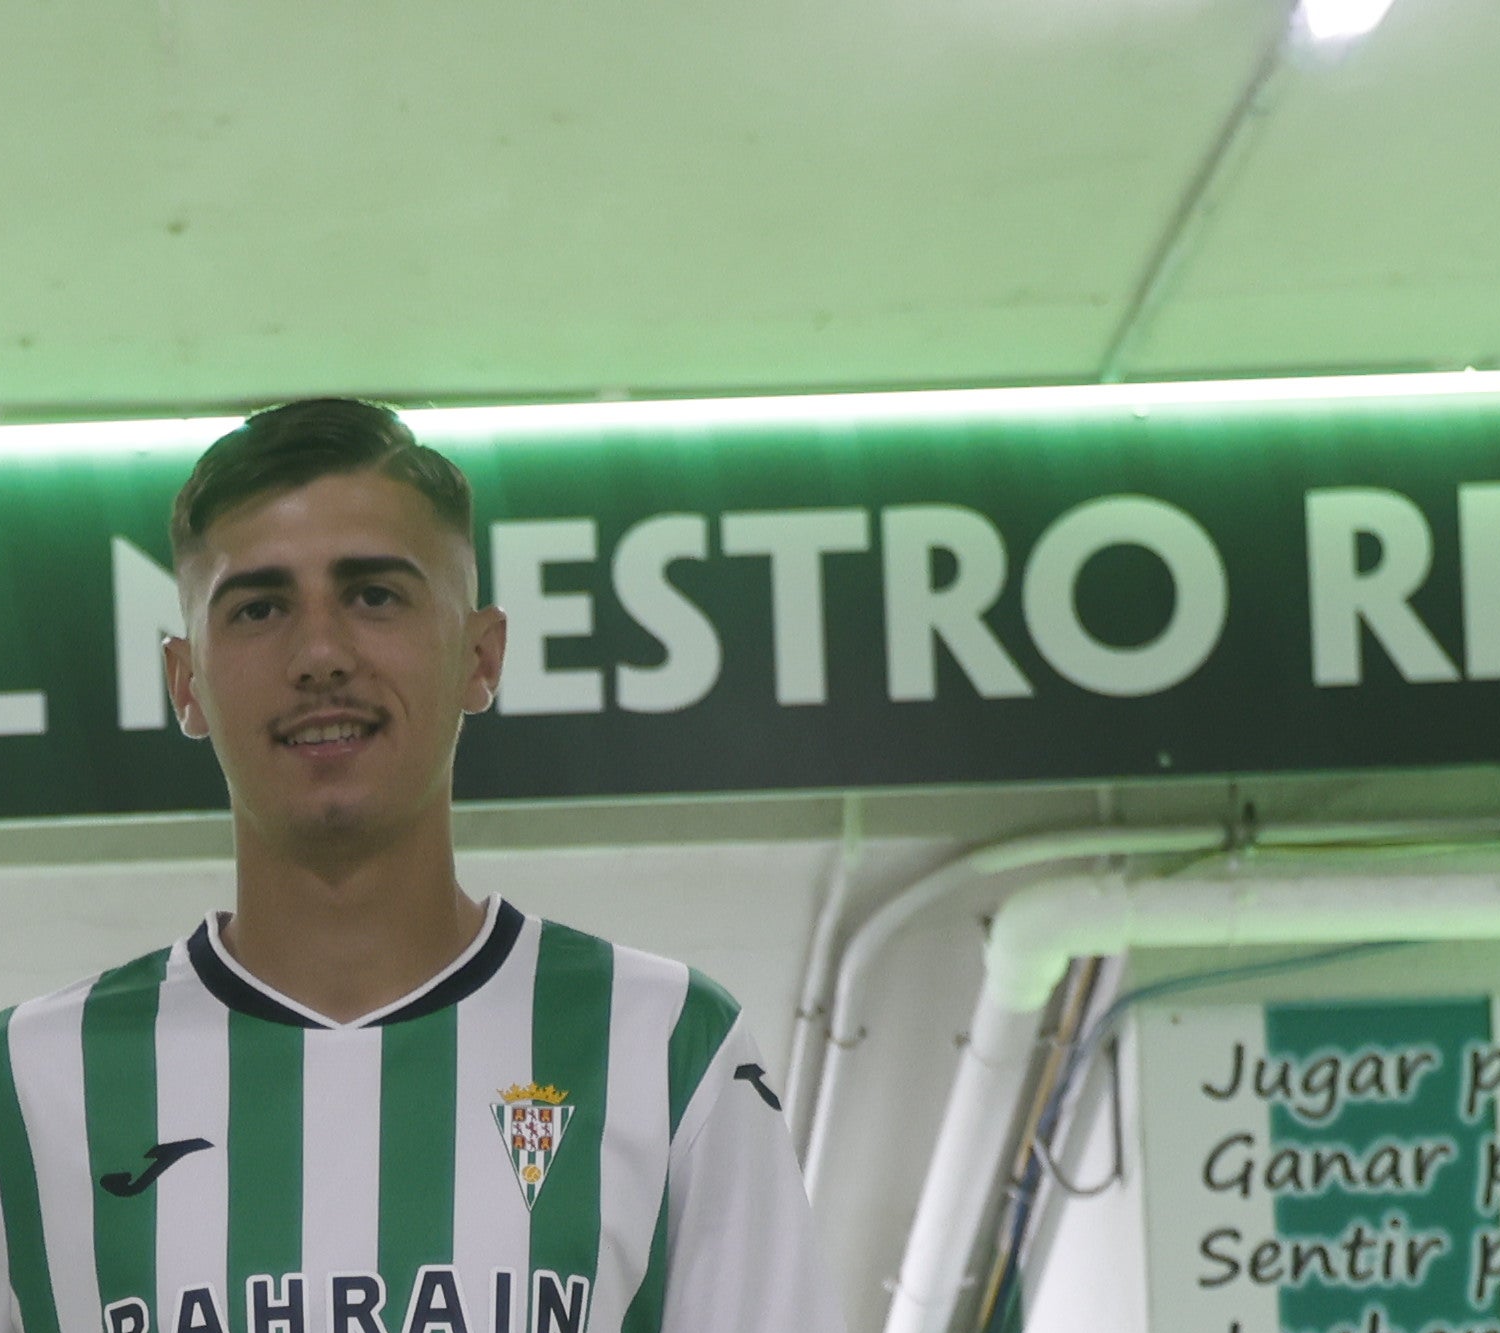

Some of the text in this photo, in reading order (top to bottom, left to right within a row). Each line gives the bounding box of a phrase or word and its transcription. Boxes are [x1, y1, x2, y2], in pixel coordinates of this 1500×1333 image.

[111, 492, 1228, 732] NESTRO
[1201, 1042, 1437, 1121] Jugar
[1201, 1131, 1452, 1197] Ganar
[1197, 1219, 1444, 1288] Sentir
